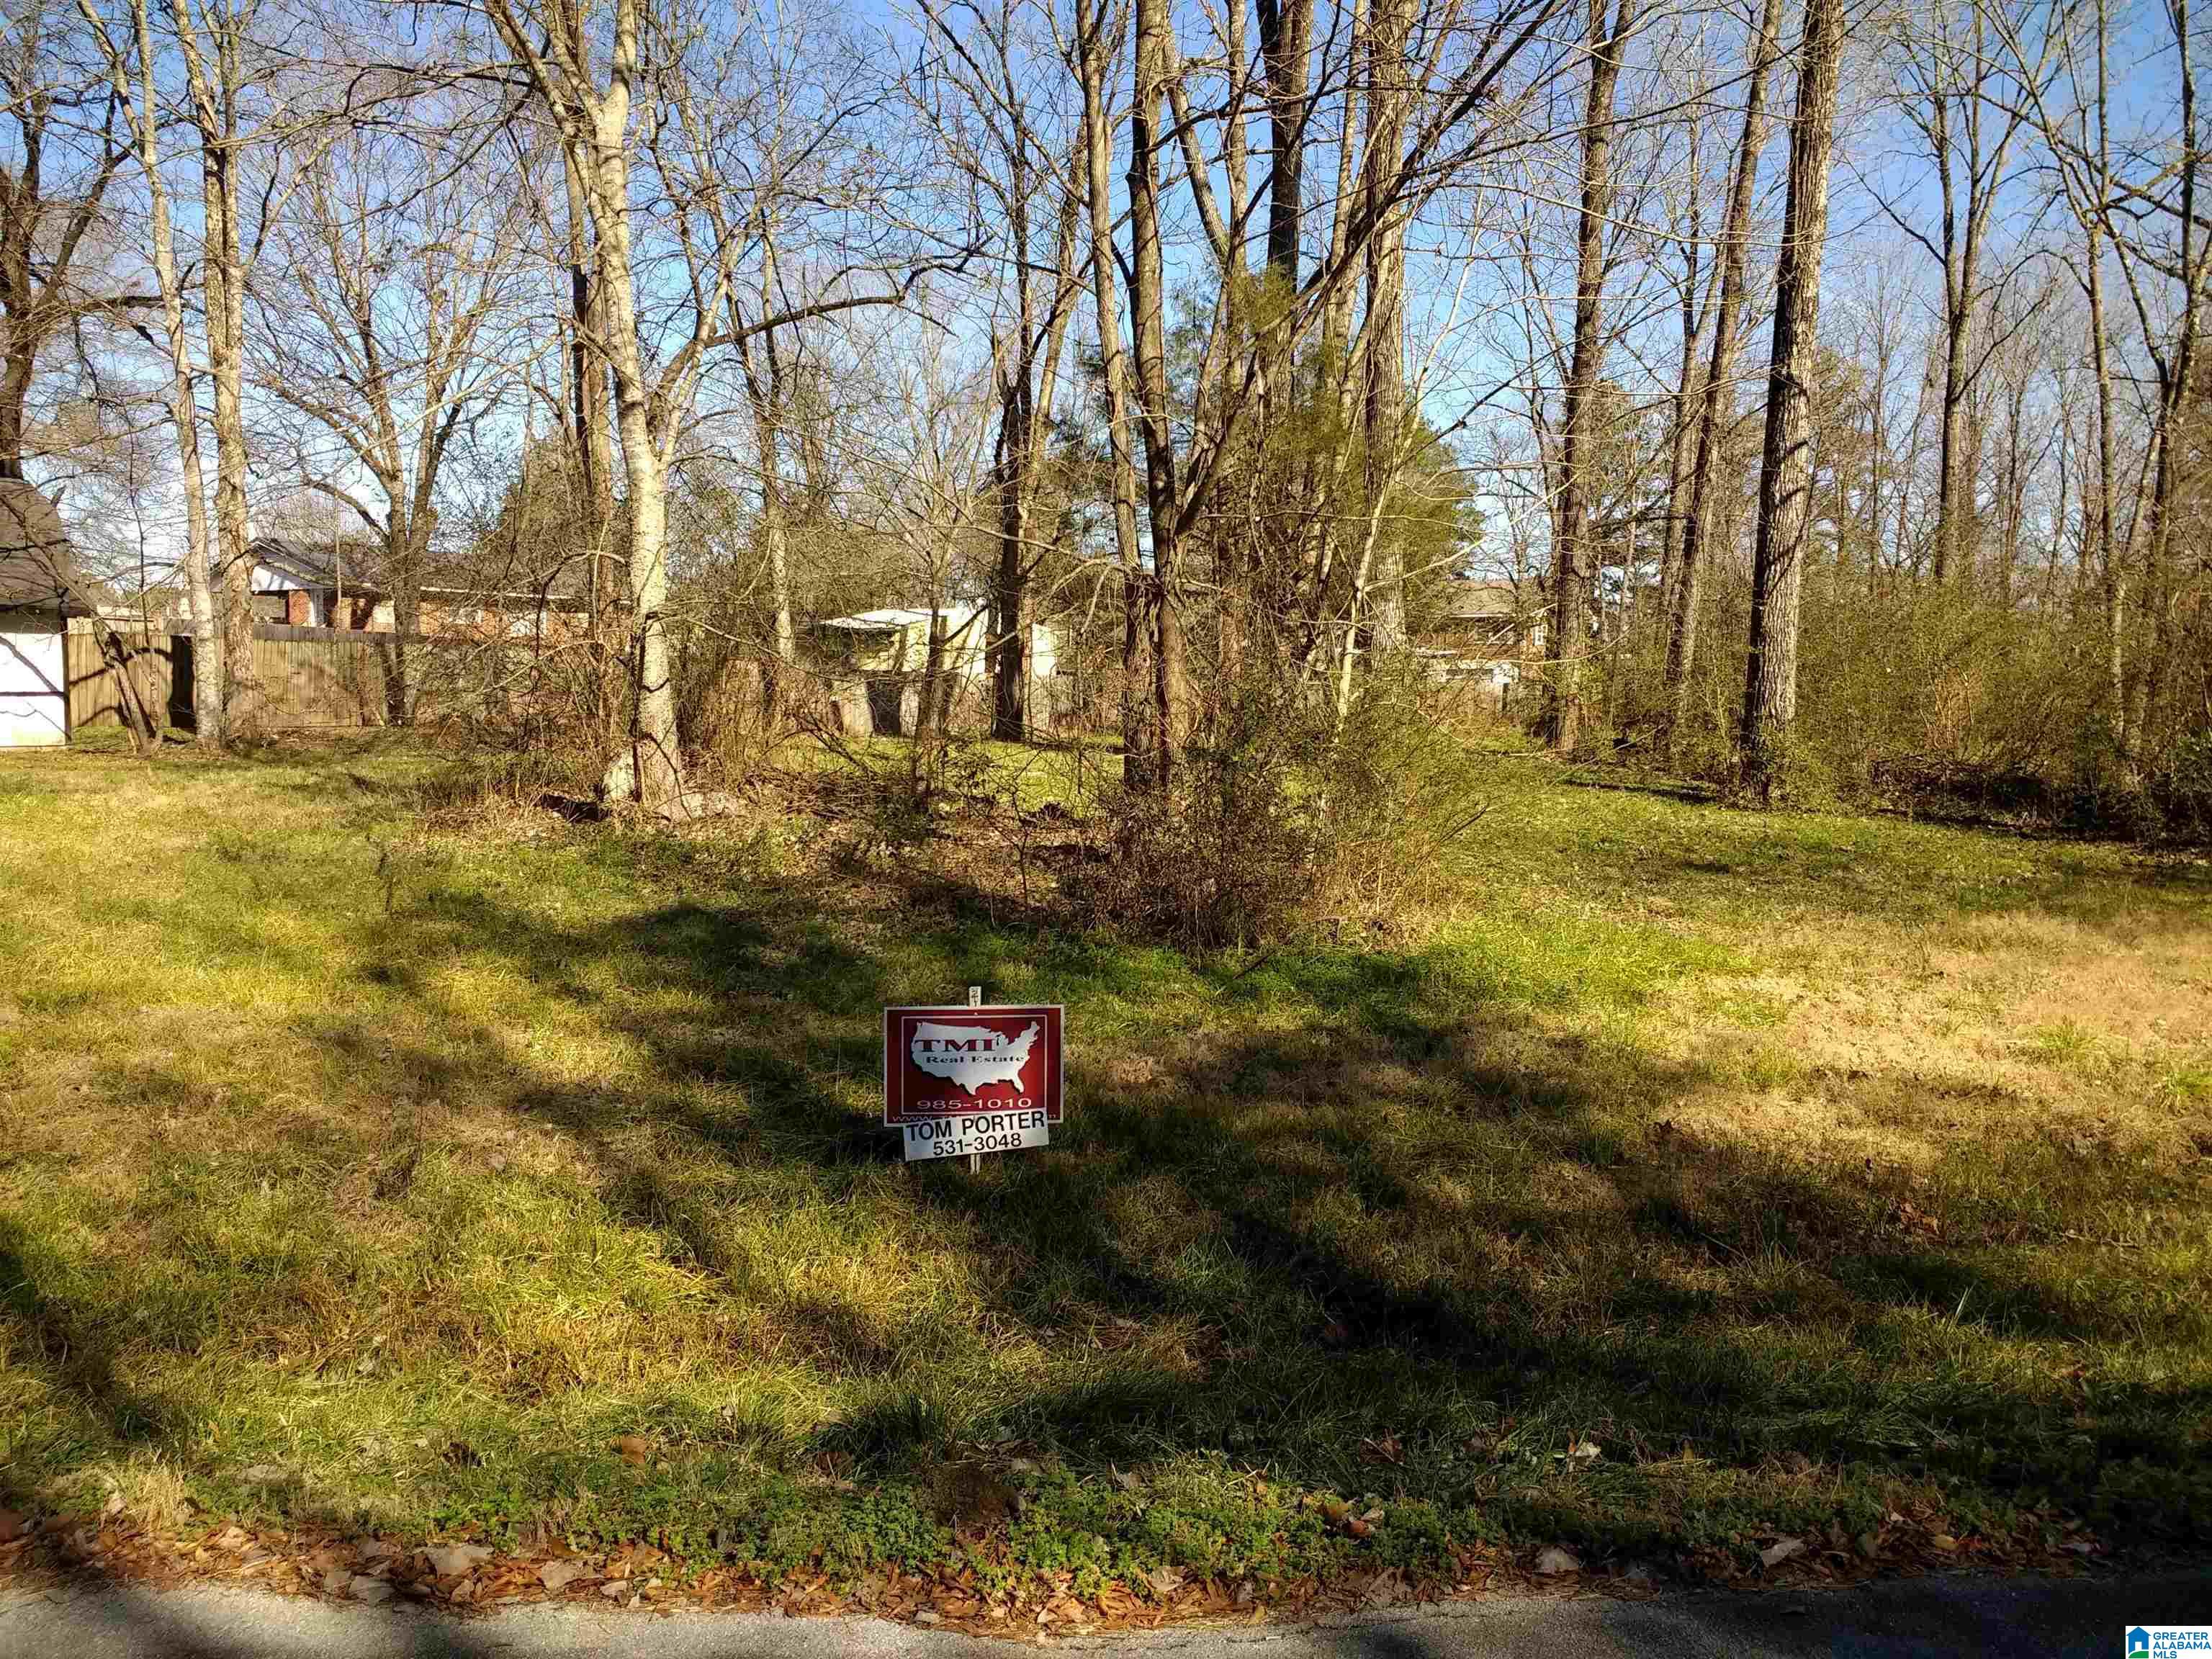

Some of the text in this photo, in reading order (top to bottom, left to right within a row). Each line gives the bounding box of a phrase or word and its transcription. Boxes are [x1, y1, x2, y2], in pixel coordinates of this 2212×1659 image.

[914, 1039, 996, 1052] TMI
[917, 1097, 1032, 1110] 985-1010
[906, 1110, 1046, 1141] TOM PORTER
[933, 1133, 1022, 1156] 531-3048
